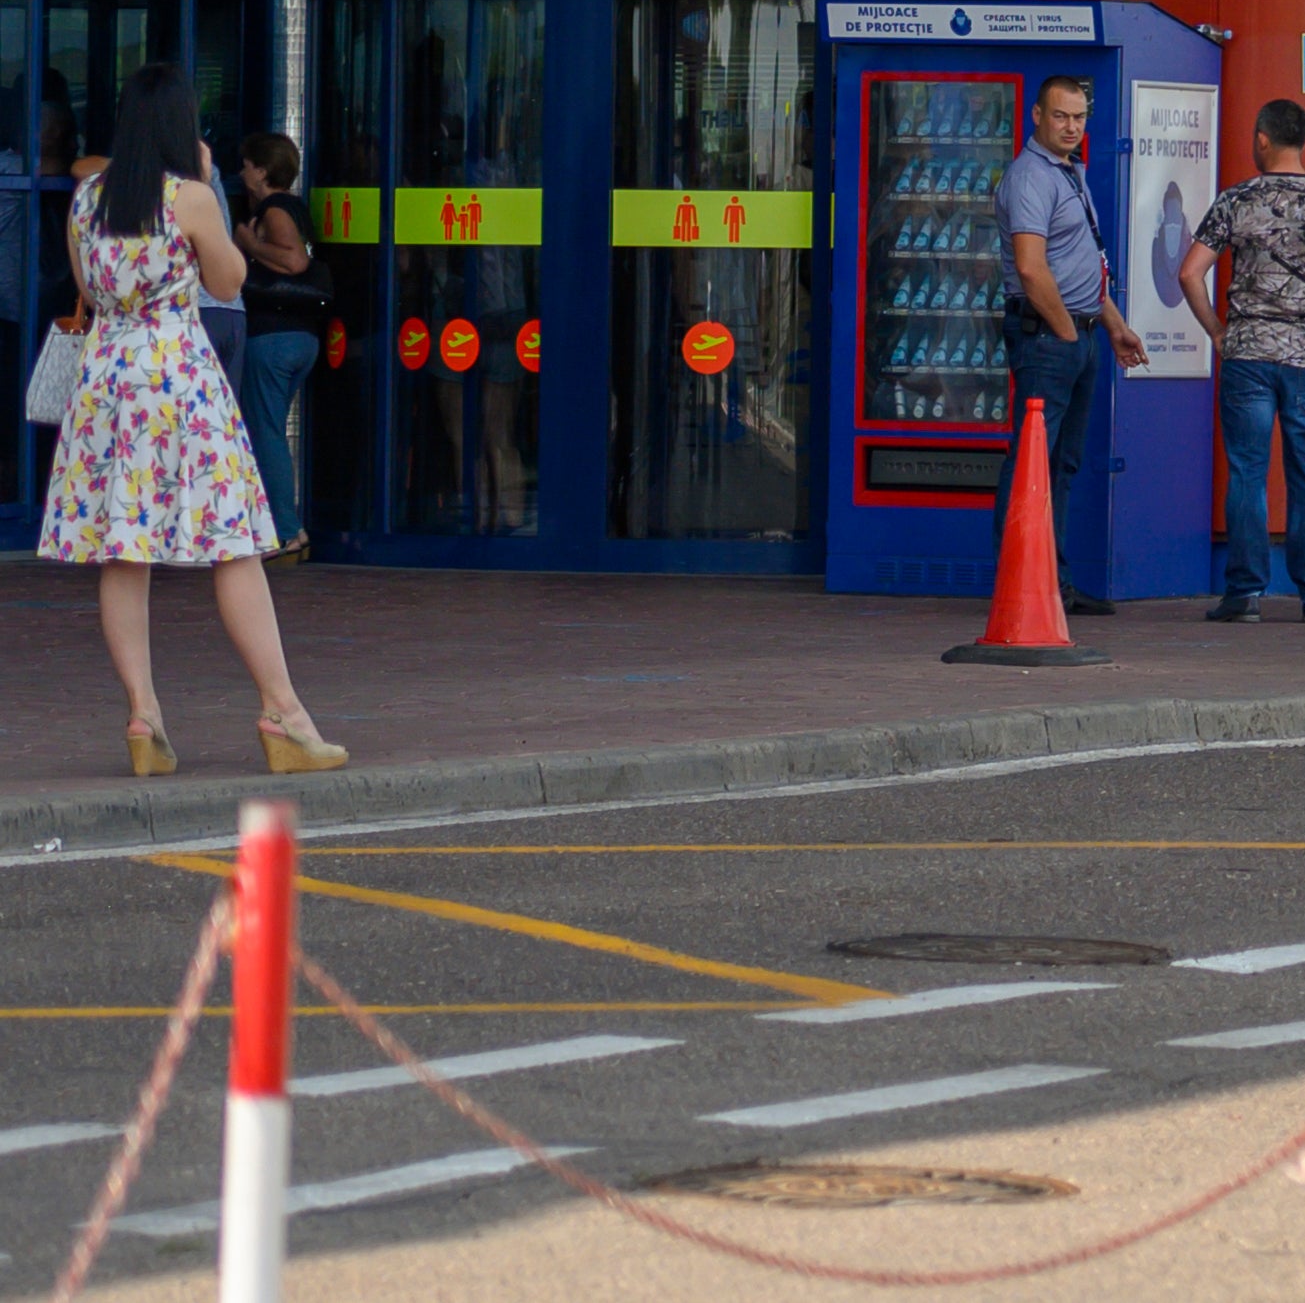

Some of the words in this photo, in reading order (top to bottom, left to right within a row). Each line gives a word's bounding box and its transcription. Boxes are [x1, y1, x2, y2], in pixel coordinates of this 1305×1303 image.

[857, 6, 919, 20] MIJLOACE
[983, 14, 1026, 23] СРЕДСТВА
[1036, 14, 1062, 23] VIRUS
[845, 21, 862, 33] DE
[866, 22, 934, 37] PROTECȚIE
[988, 24, 1028, 33] ЗАЩИТЫ
[1037, 24, 1091, 34] PROTECTION
[1150, 108, 1200, 131] MIJLOACE
[1139, 137, 1153, 157] DE
[1156, 139, 1209, 164] PROTECȚIE
